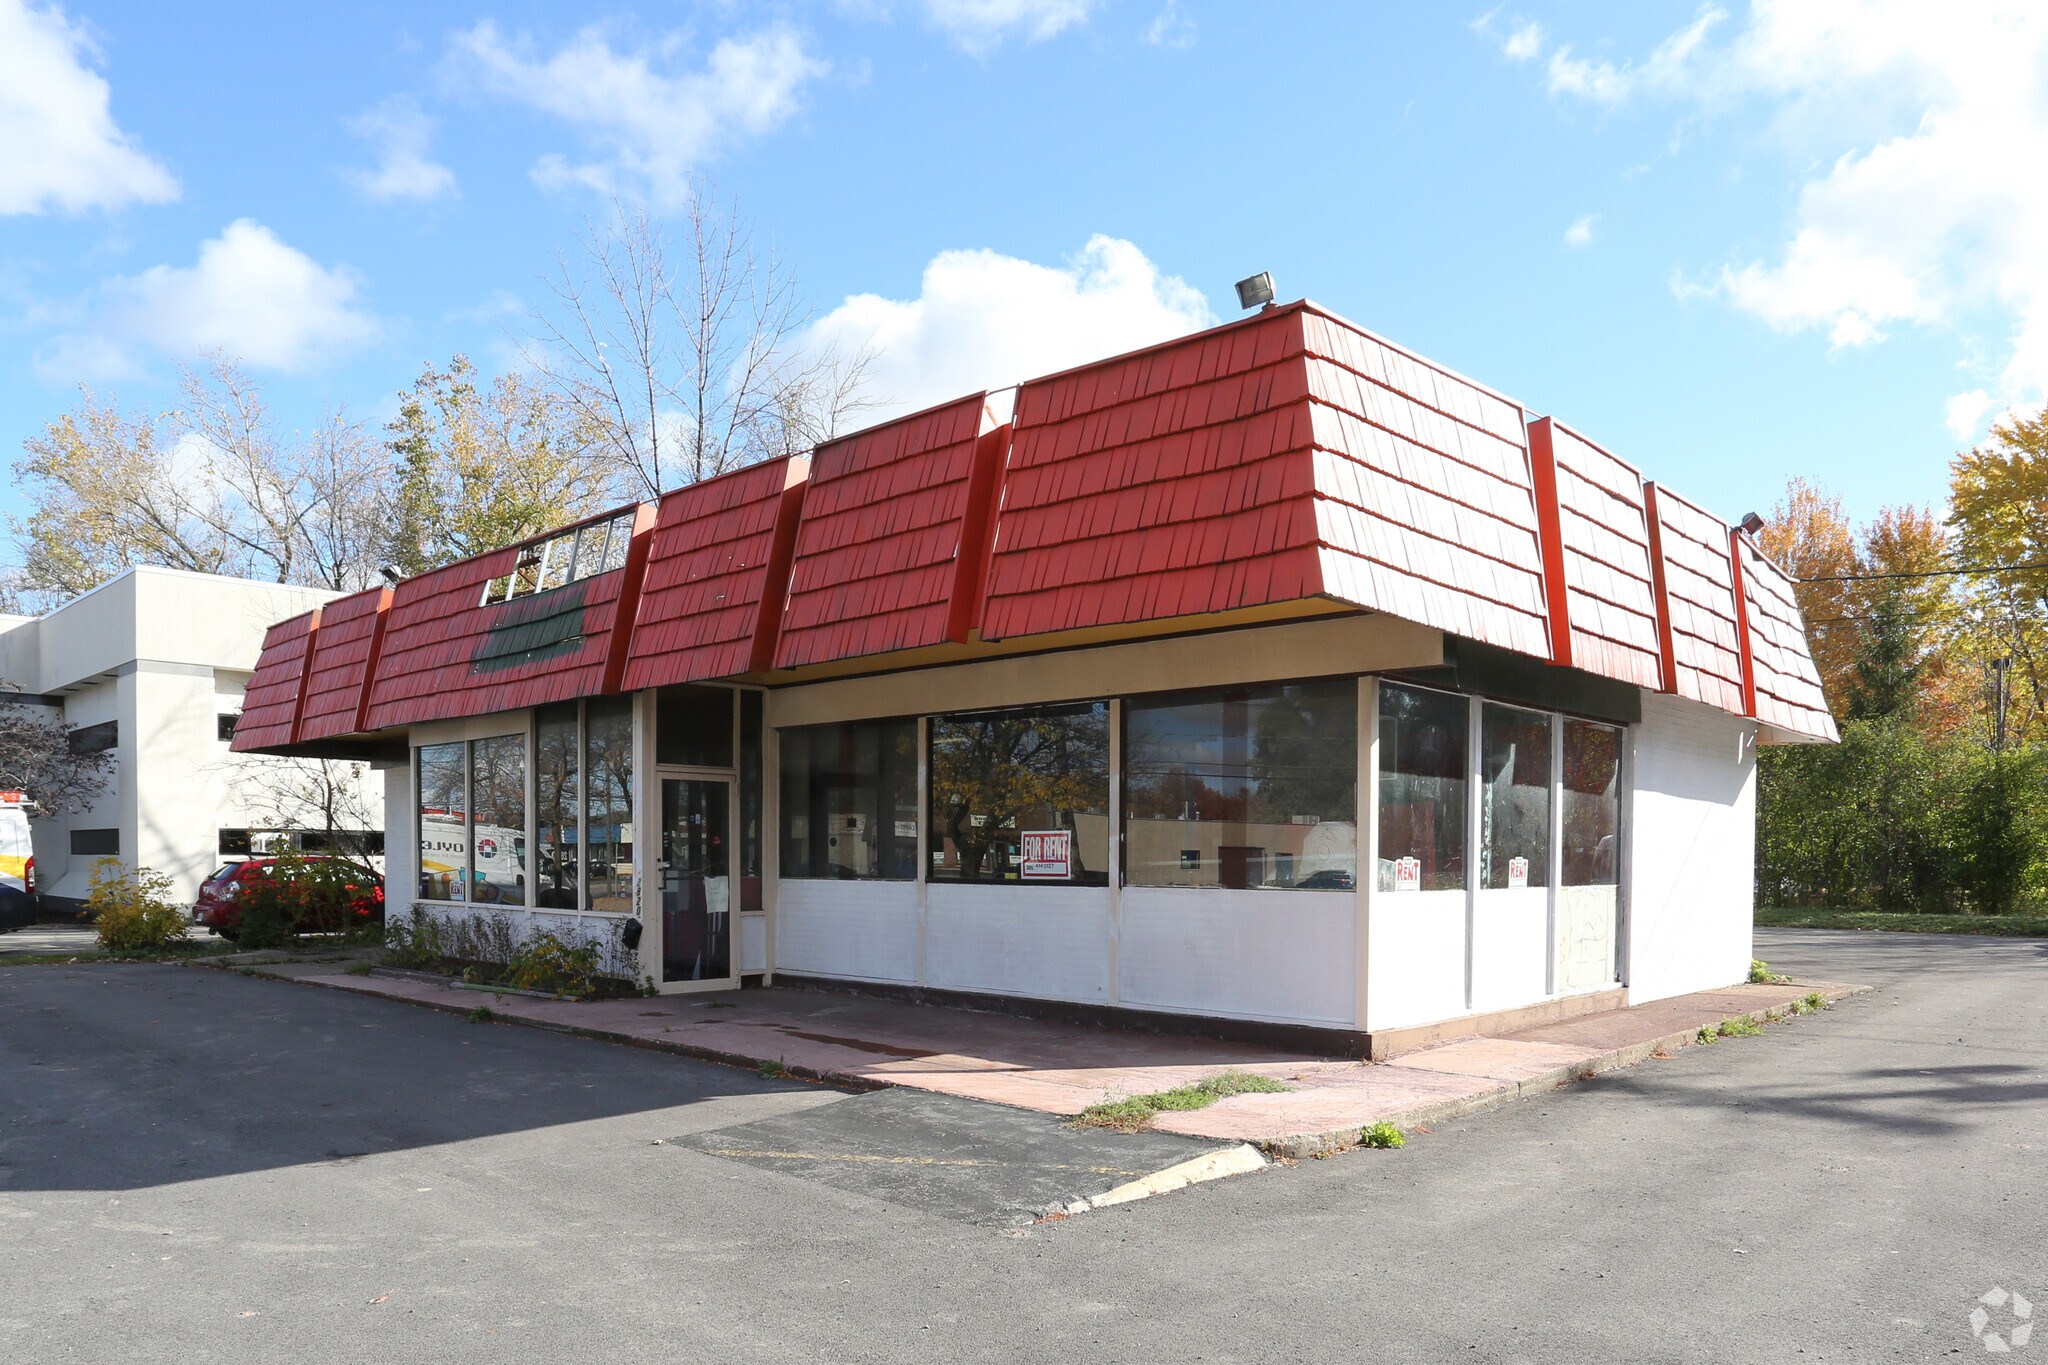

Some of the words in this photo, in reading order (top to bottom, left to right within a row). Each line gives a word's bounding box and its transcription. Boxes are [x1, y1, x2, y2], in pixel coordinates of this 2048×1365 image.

[1024, 836, 1041, 860] FOR
[1044, 836, 1067, 860] RENT
[1397, 861, 1418, 881] RENT
[1510, 861, 1527, 879] RENT
